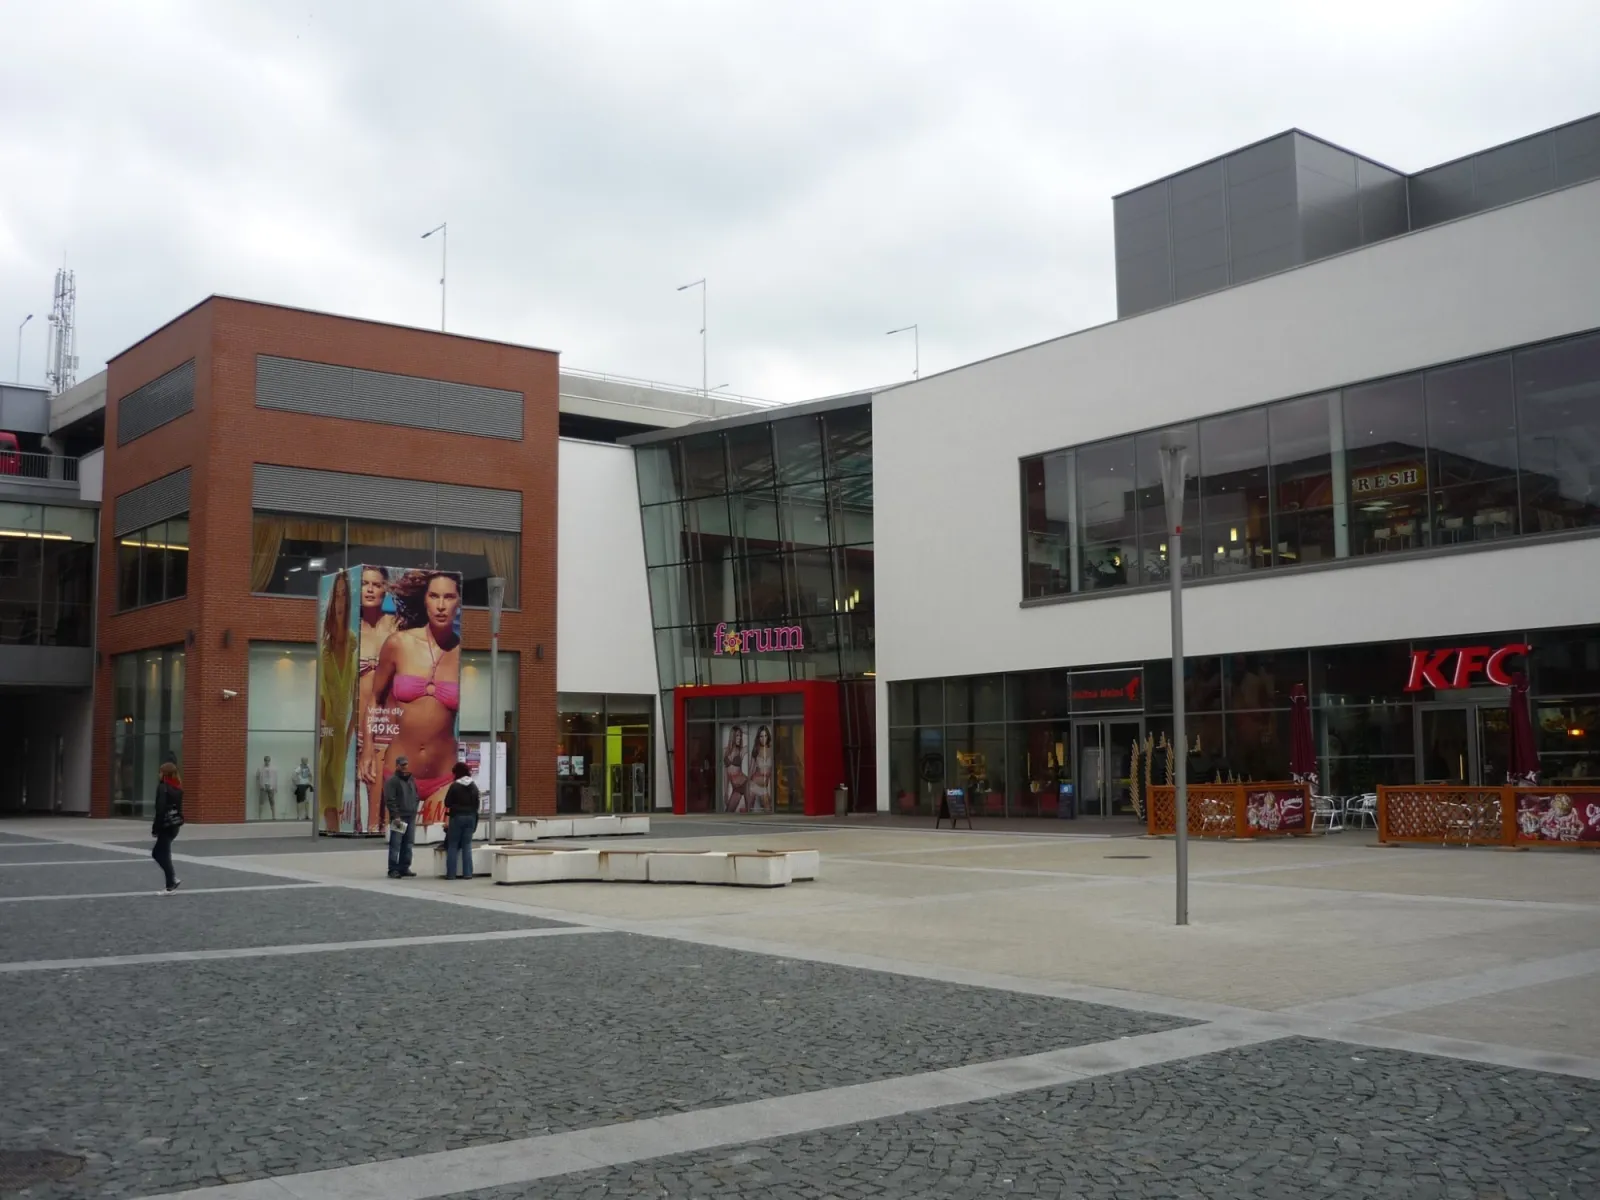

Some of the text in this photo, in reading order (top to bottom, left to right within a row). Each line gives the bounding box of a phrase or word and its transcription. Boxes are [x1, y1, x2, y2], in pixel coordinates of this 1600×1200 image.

[713, 622, 804, 655] forum
[1403, 643, 1528, 692] KFC
[367, 723, 400, 735] 149 Kč
